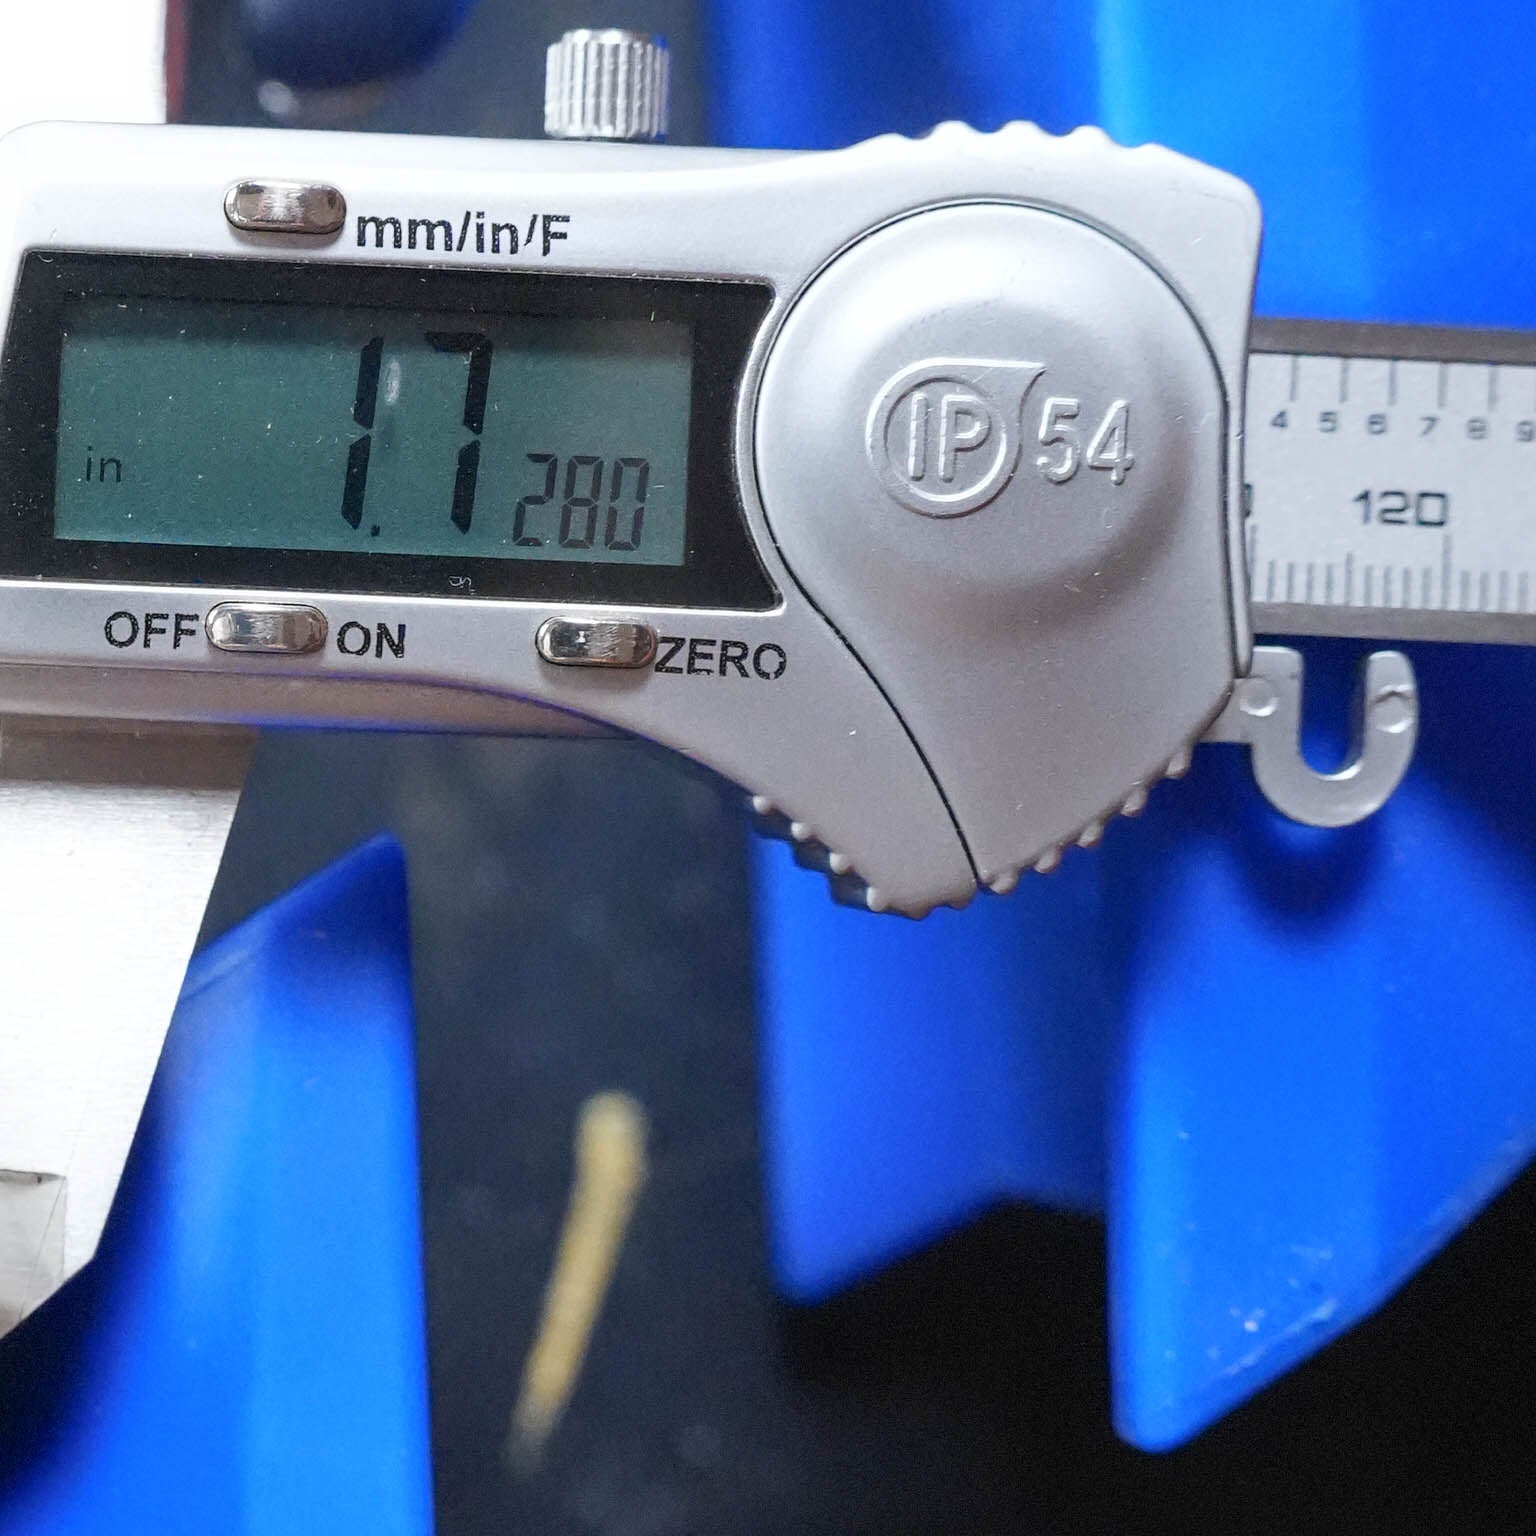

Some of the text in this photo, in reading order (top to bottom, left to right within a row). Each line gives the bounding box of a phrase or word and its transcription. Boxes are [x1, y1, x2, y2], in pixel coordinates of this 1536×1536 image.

[356, 210, 571, 257] mm/in/F
[907, 391, 1137, 486] IP 54
[1269, 408, 1289, 431] 4
[1318, 410, 1340, 434] 5
[1365, 412, 1389, 436] 6
[1419, 415, 1441, 438] 7
[1465, 416, 1489, 441] 8
[83, 443, 123, 484] in
[1351, 488, 1449, 529] 120
[103, 610, 201, 650] OFF
[336, 620, 407, 660] ON
[652, 635, 789, 682] ZERO
